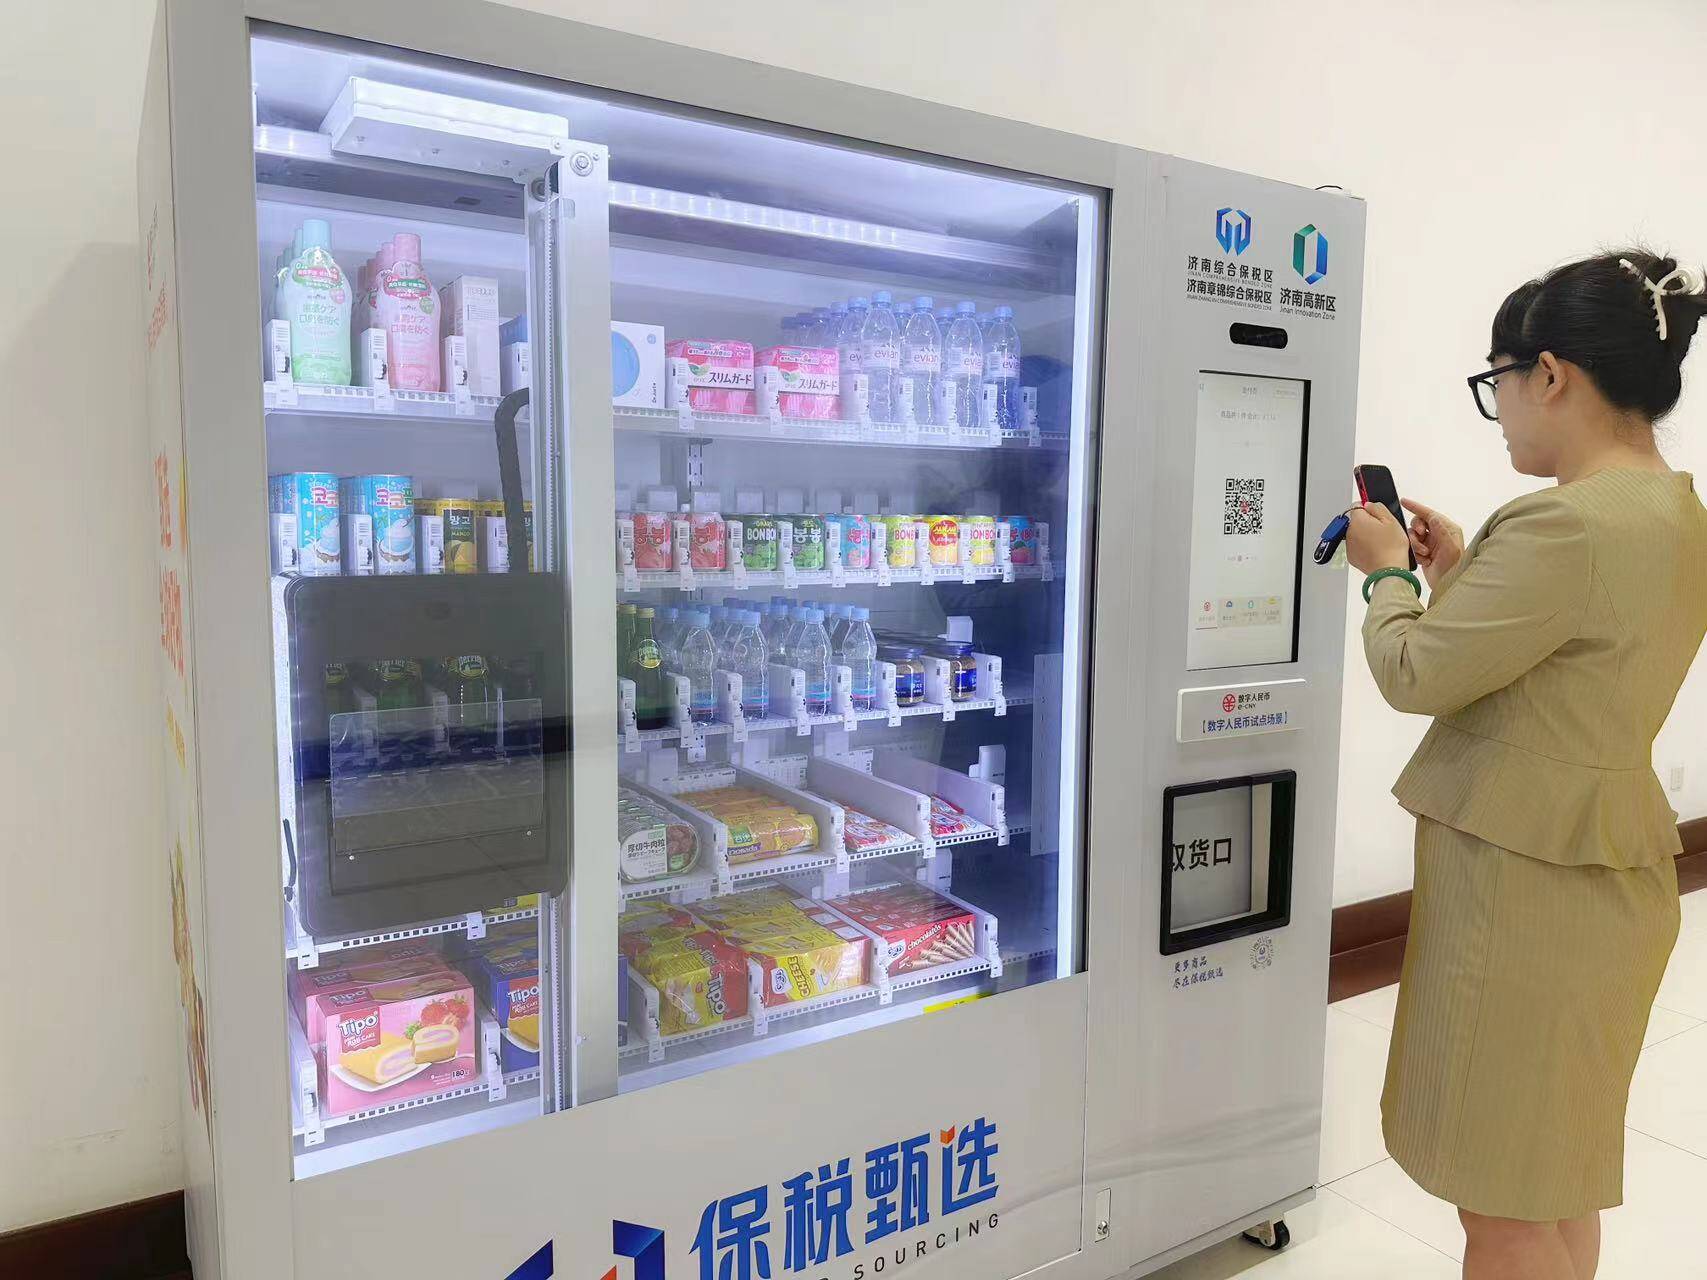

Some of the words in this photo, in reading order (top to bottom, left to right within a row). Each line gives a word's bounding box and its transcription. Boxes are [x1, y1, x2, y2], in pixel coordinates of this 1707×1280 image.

[1187, 255, 1273, 283] 济南综合保税区
[1186, 278, 1273, 304] 济南章锦综合保税区
[1279, 287, 1337, 312] 济南高新区
[1279, 305, 1294, 315] Jinan
[1295, 307, 1321, 320] Innovation
[1322, 310, 1336, 321] Zone
[708, 371, 752, 385] スリムガード
[798, 378, 839, 390] スリムガード
[1238, 692, 1271, 704] 数字人民币
[505, 985, 540, 1003] Tipo
[337, 1014, 378, 1037] Tipo
[688, 1116, 1000, 1280] 保税甄选
[853, 1212, 1000, 1280] SOURCING
